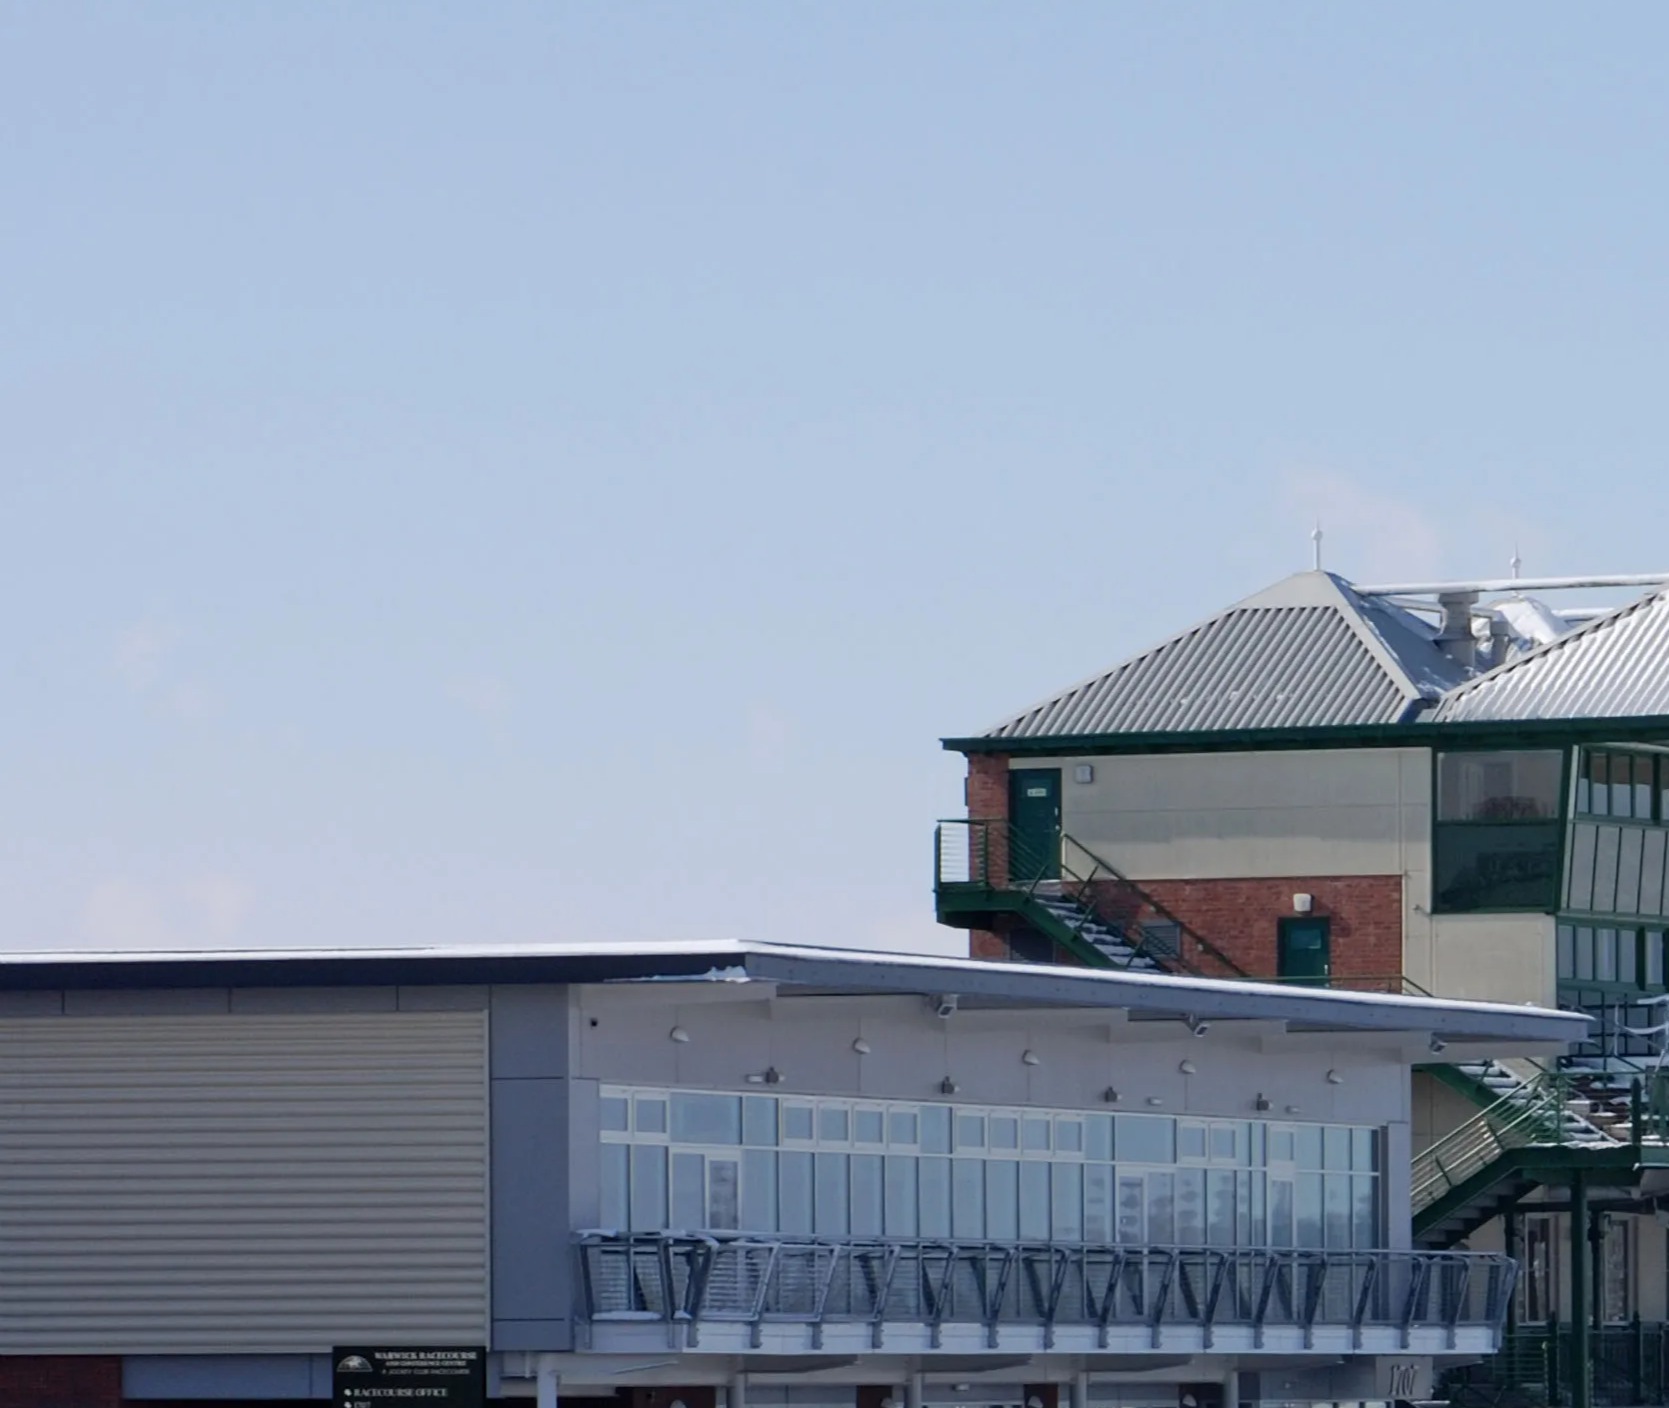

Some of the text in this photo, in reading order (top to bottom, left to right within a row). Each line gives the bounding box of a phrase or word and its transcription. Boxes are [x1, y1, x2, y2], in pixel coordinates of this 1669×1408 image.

[374, 1351, 477, 1360] WARWICK RACECOURSE
[353, 1388, 448, 1397] RACECOURSE OFFICE
